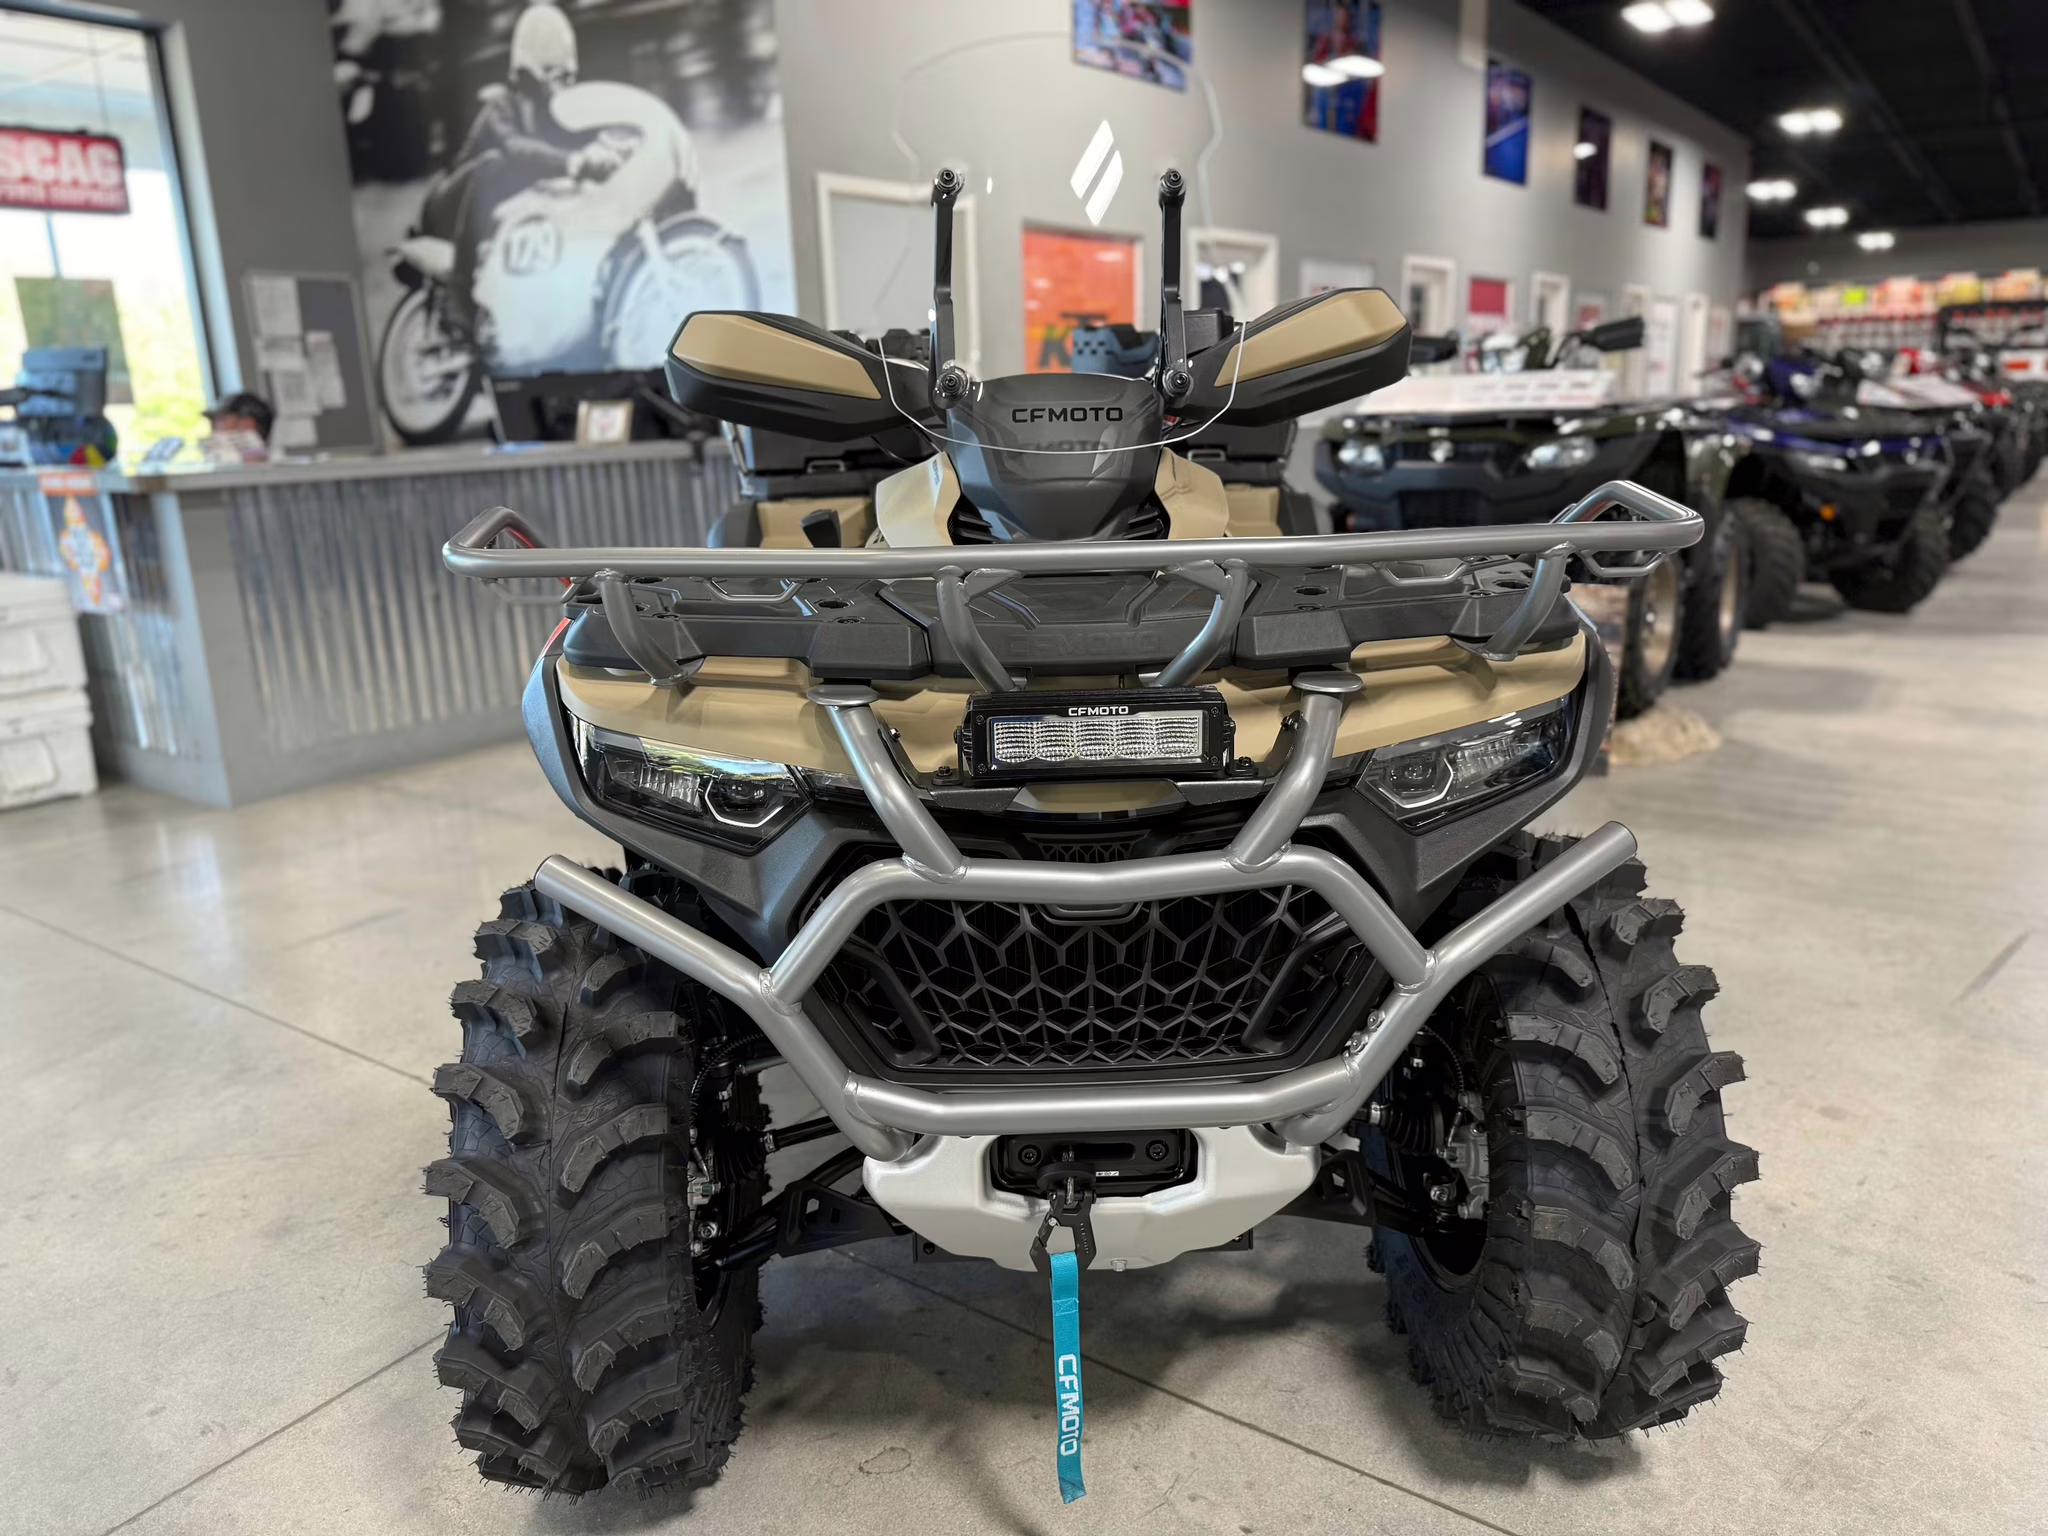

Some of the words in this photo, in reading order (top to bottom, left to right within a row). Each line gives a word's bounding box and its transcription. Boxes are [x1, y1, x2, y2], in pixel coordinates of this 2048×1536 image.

[0, 134, 121, 187] SCAG
[1012, 407, 1123, 423] CFMOTO
[1068, 706, 1129, 716] CFMOTO
[1058, 1353, 1080, 1456] CFMOTO
